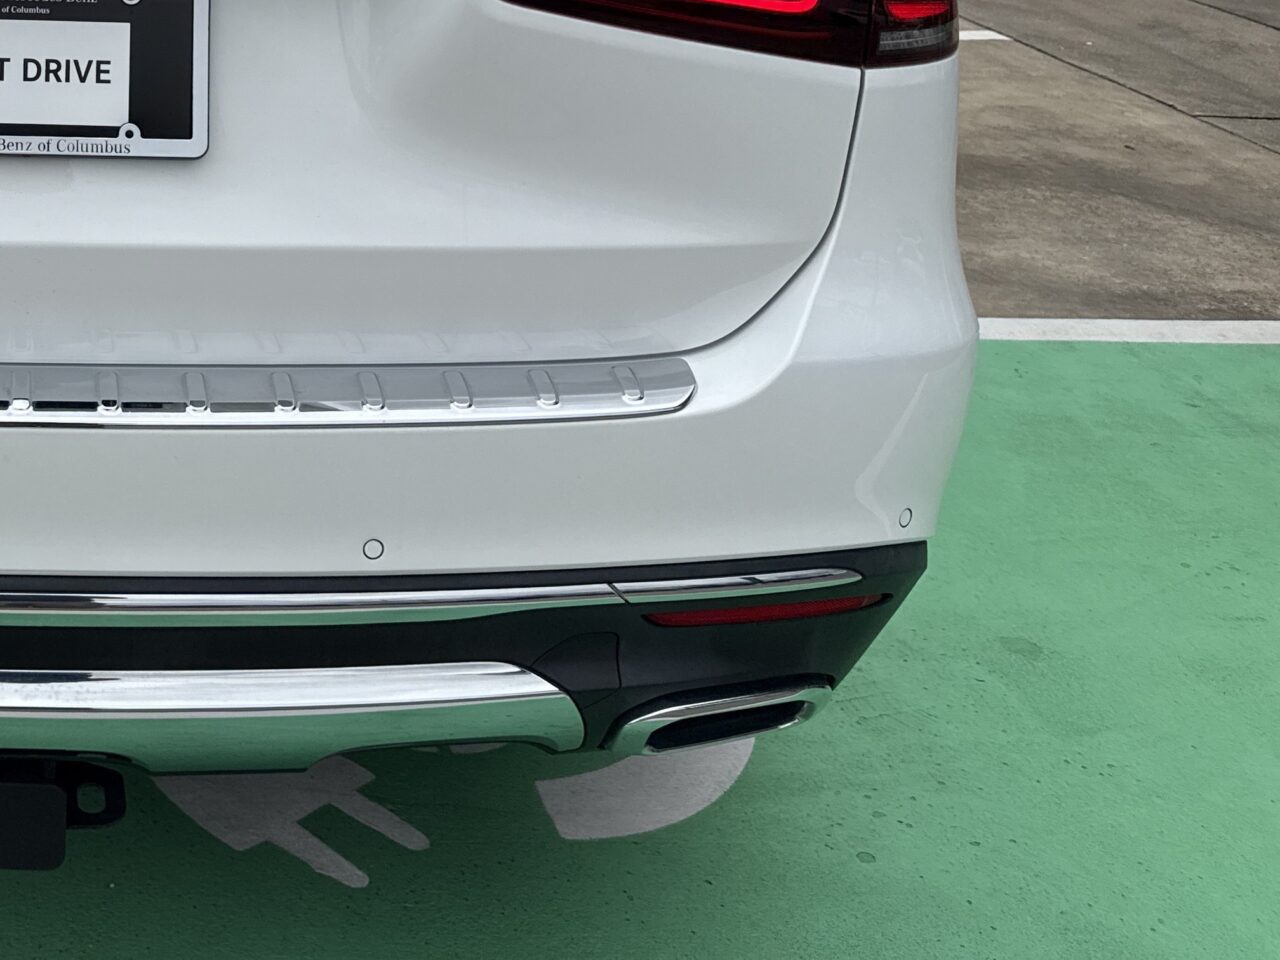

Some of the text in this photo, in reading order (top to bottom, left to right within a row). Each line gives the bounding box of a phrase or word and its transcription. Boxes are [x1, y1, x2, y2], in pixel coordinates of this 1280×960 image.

[11, 5, 50, 14] Columbus
[22, 58, 112, 84] DRIVE
[38, 139, 52, 152] of
[56, 140, 131, 154] Columbus
